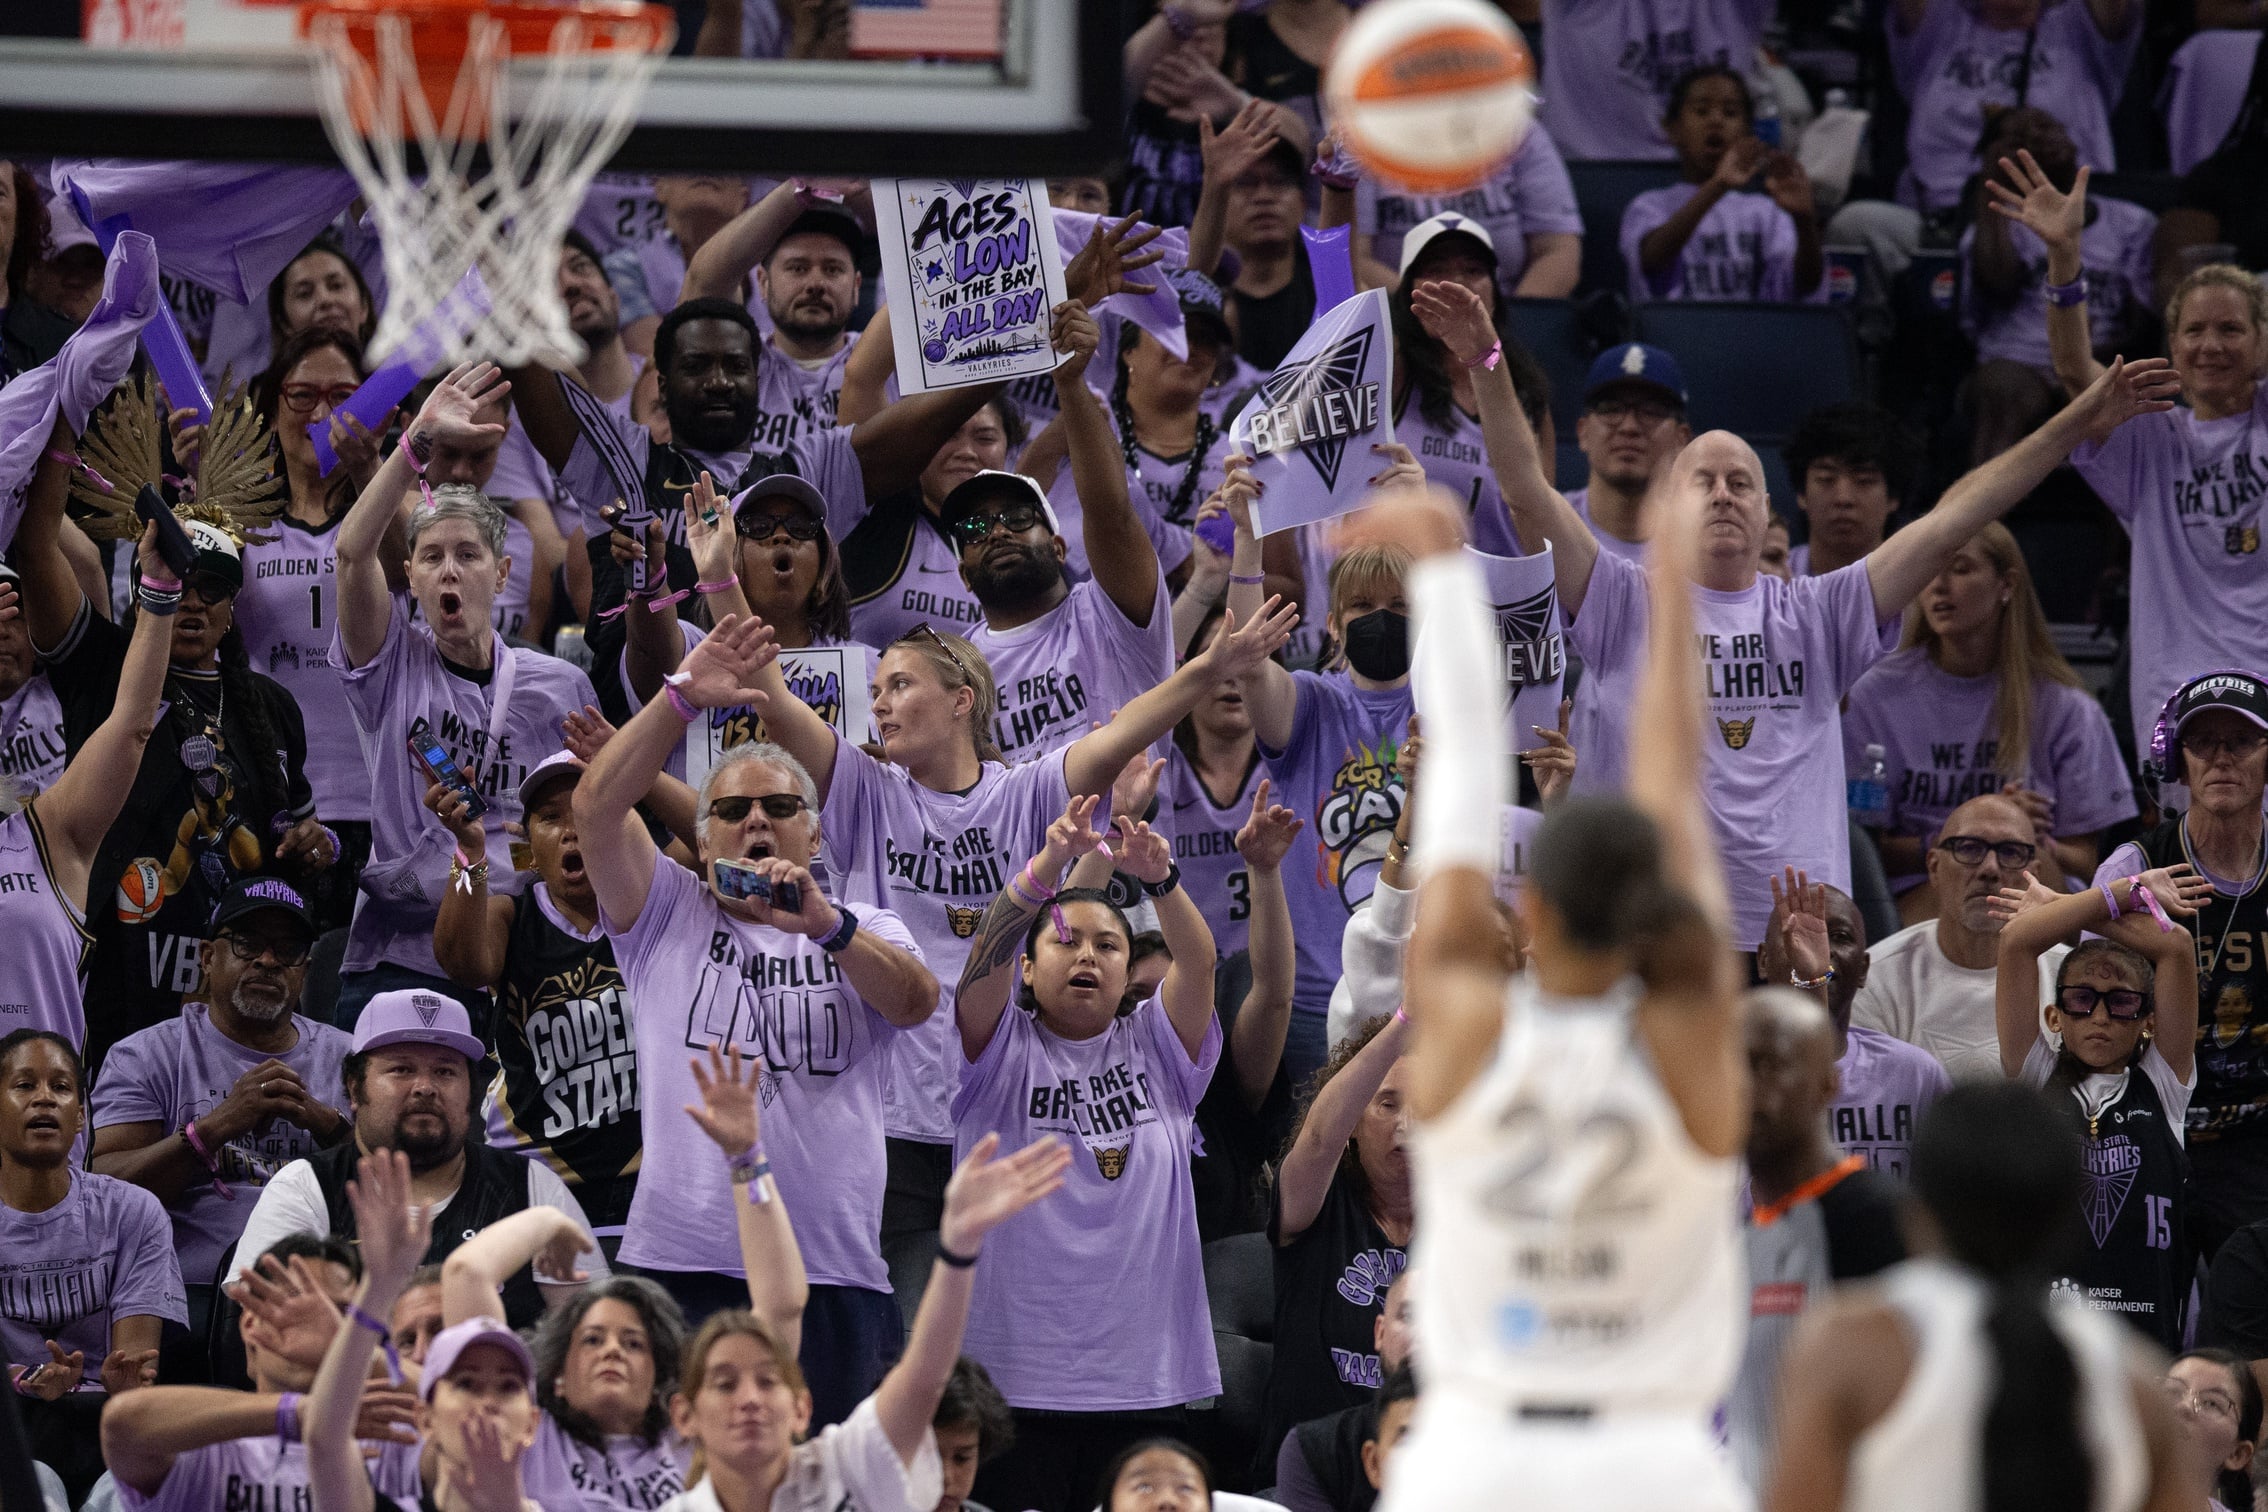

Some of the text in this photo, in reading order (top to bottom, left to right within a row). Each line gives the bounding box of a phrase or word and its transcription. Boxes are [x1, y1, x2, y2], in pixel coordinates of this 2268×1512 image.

[911, 191, 1018, 252] ACES
[954, 218, 1031, 284] LOW
[939, 264, 1038, 310] IN THE BAY
[940, 287, 1045, 344] ALL DAY
[967, 358, 1012, 373] VALKYRIES
[1249, 381, 1379, 457] BELIEVE
[1421, 435, 1481, 465] GOLDEN
[256, 558, 318, 579] GOLDEN
[308, 584, 323, 630] 1
[902, 589, 983, 623] GOLDEN
[305, 648, 329, 658] KAIS
[1495, 632, 1561, 684] IEVE
[1732, 633, 1764, 659] AR
[1017, 666, 1059, 706] ARE
[993, 673, 1088, 753] LHALLA
[952, 826, 996, 861] ARE
[1174, 829, 1238, 859] OLDEN
[0, 872, 39, 894] ATE
[244, 884, 304, 909] VALKYRIES
[148, 931, 201, 994] VB
[685, 961, 853, 1077] LOUD
[1088, 1061, 1134, 1101] ARE
[2103, 1134, 2131, 1148] STATE
[2080, 1145, 2142, 1175] LKYRIES
[2144, 1194, 2172, 1250] 15
[2088, 1286, 2122, 1299] KAISER
[2088, 1300, 2156, 1314] PERMANENTE
